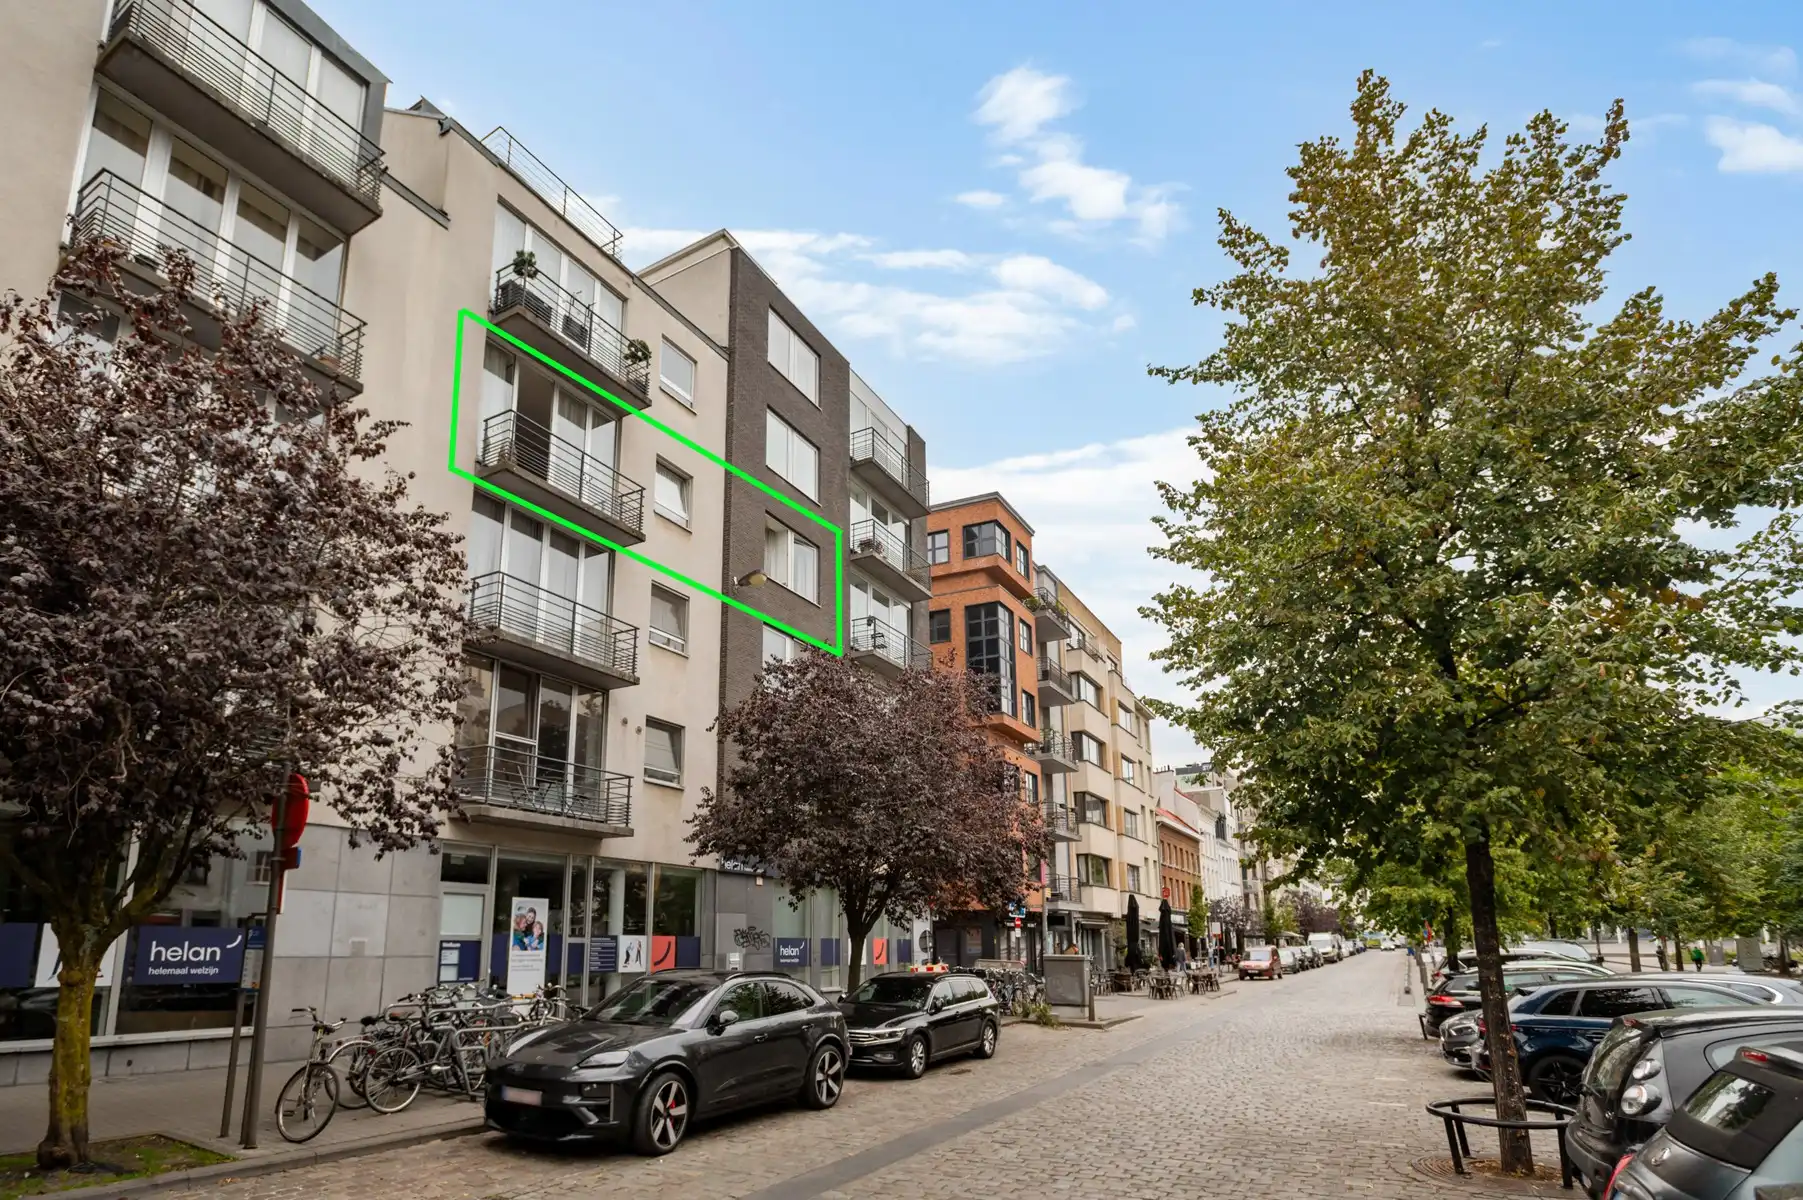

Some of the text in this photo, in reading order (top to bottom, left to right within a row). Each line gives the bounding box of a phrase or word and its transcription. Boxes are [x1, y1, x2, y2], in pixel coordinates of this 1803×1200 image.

[150, 940, 221, 961] helan
[780, 945, 800, 956] helan
[148, 966, 219, 976] helemaal welzijn
